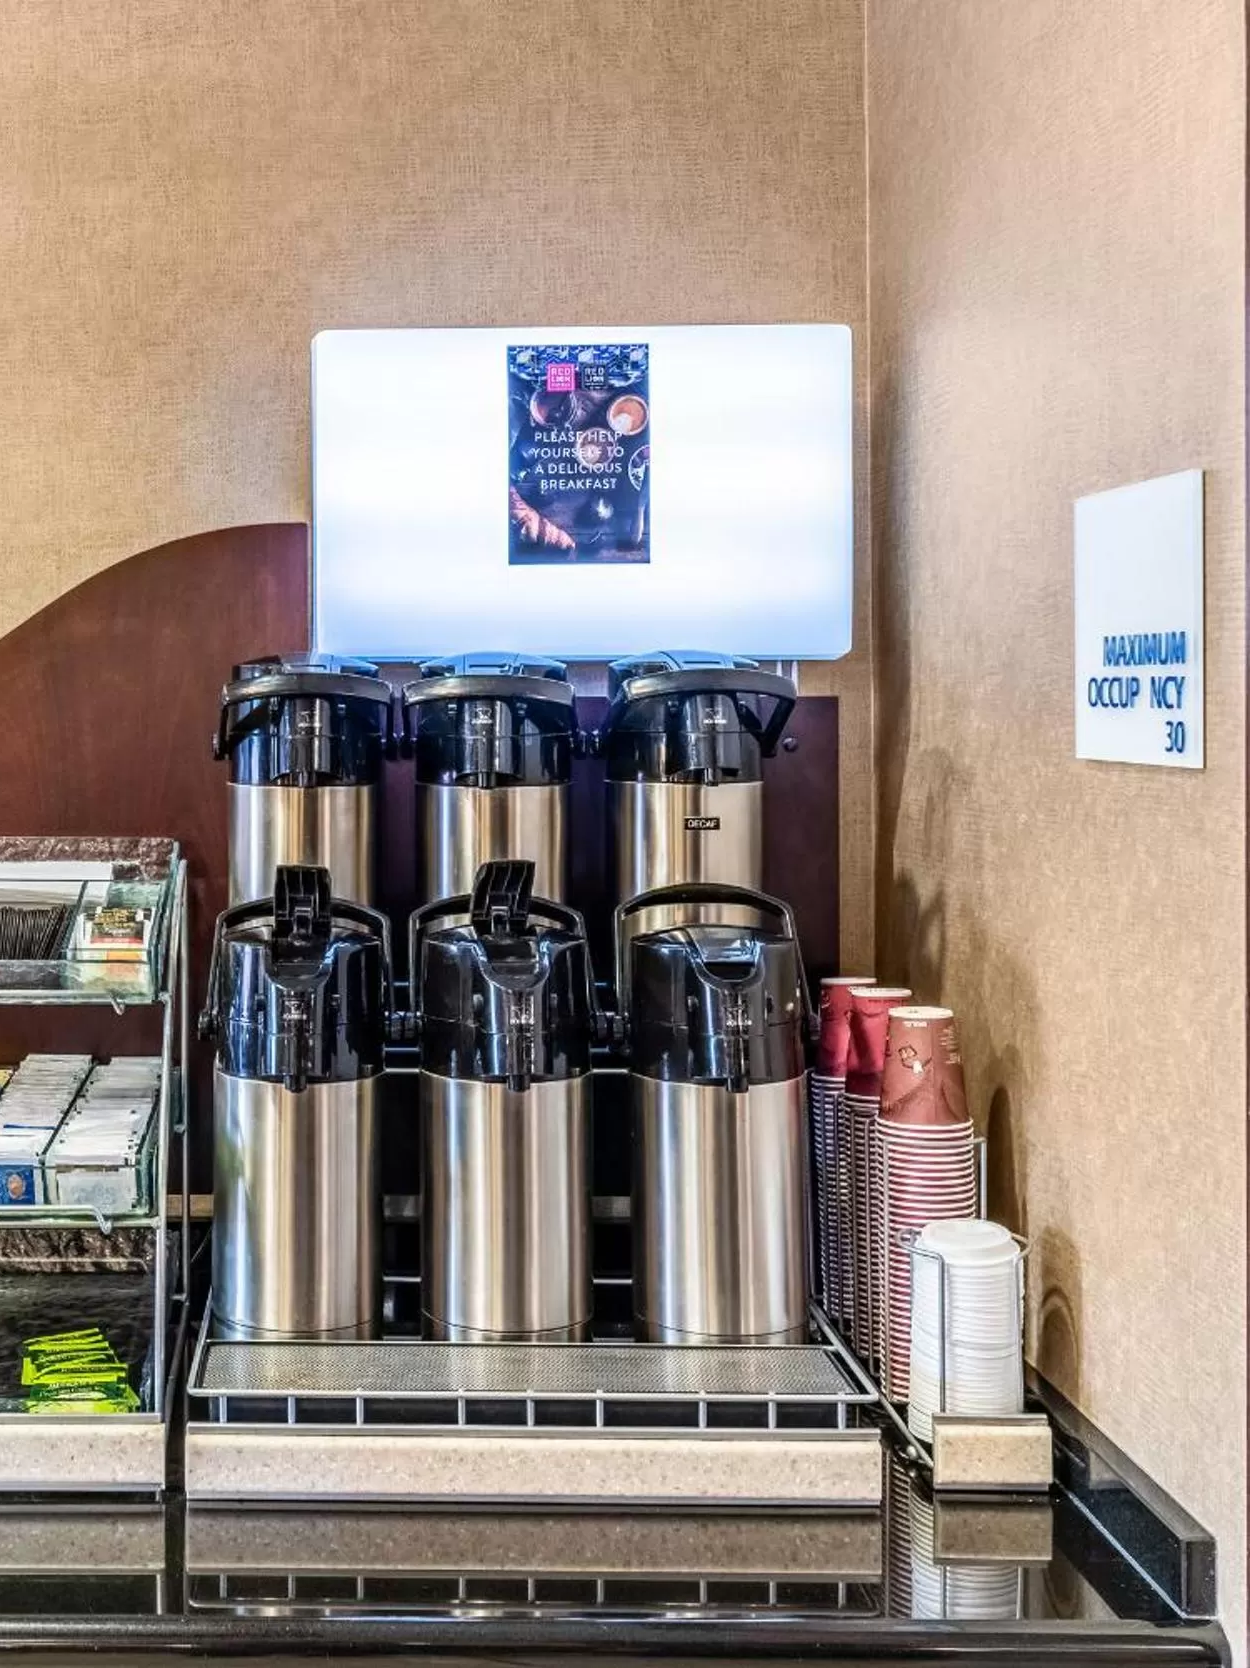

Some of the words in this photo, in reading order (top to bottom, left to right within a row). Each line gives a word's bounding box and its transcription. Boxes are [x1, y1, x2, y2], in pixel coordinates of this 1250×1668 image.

[551, 367, 570, 375] RED
[534, 431, 582, 443] PLEASE
[587, 431, 623, 442] HELP
[608, 447, 624, 457] TO
[534, 465, 544, 475] A
[548, 463, 622, 475] DELICIOUS
[541, 478, 617, 490] BREAKFAST
[1103, 631, 1186, 667] MAXIMUM
[1164, 720, 1186, 753] 30
[687, 819, 718, 828] DECAF
